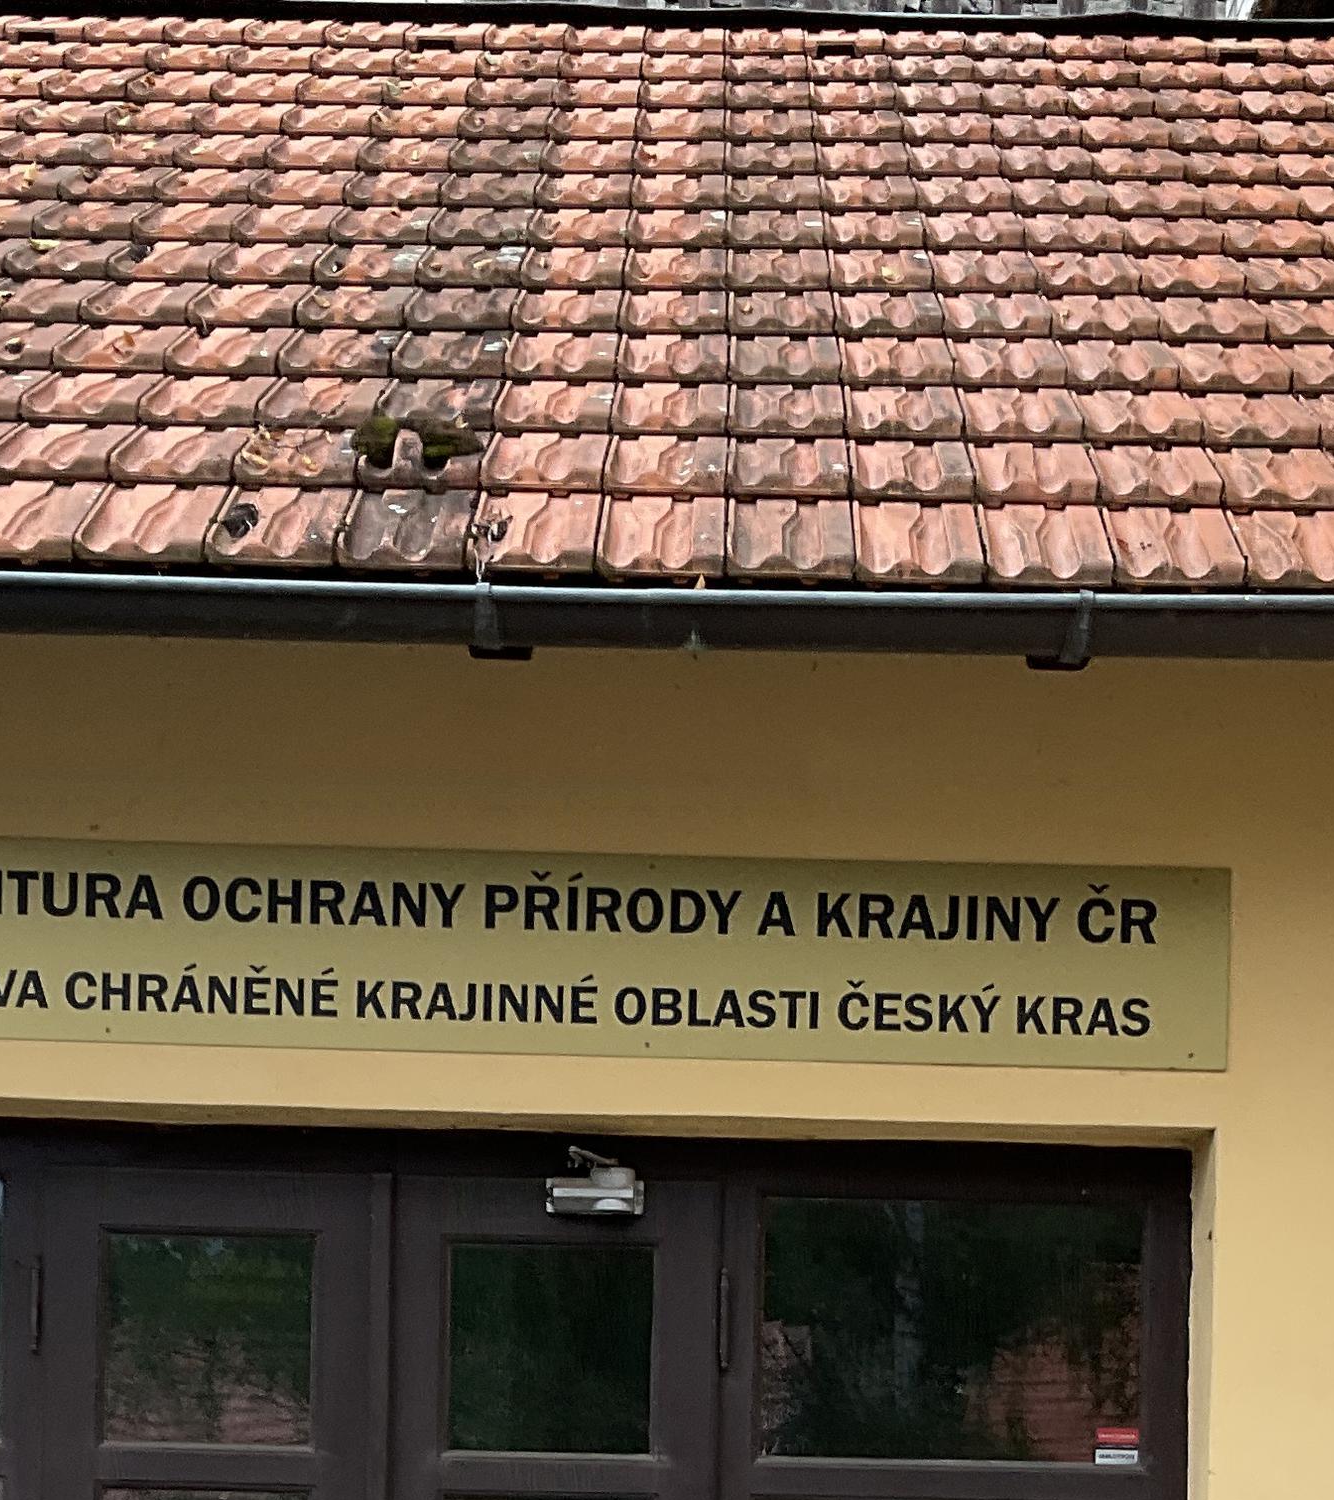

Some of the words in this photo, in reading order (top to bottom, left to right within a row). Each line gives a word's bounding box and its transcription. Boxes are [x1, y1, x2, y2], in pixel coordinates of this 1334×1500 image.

[182, 875, 467, 929] OCHRANY
[484, 869, 743, 936] PŘÍRODY
[757, 890, 796, 937] A
[816, 891, 1061, 943] KRAJINY
[1077, 884, 1158, 946] ČR
[65, 963, 338, 1018] CHRÁNĚNÉ
[356, 968, 597, 1025] KRAJINNÉ
[614, 986, 820, 1030] OBLASTI
[837, 979, 1001, 1034] ČESKÝ
[1016, 995, 1152, 1037] KRAS
